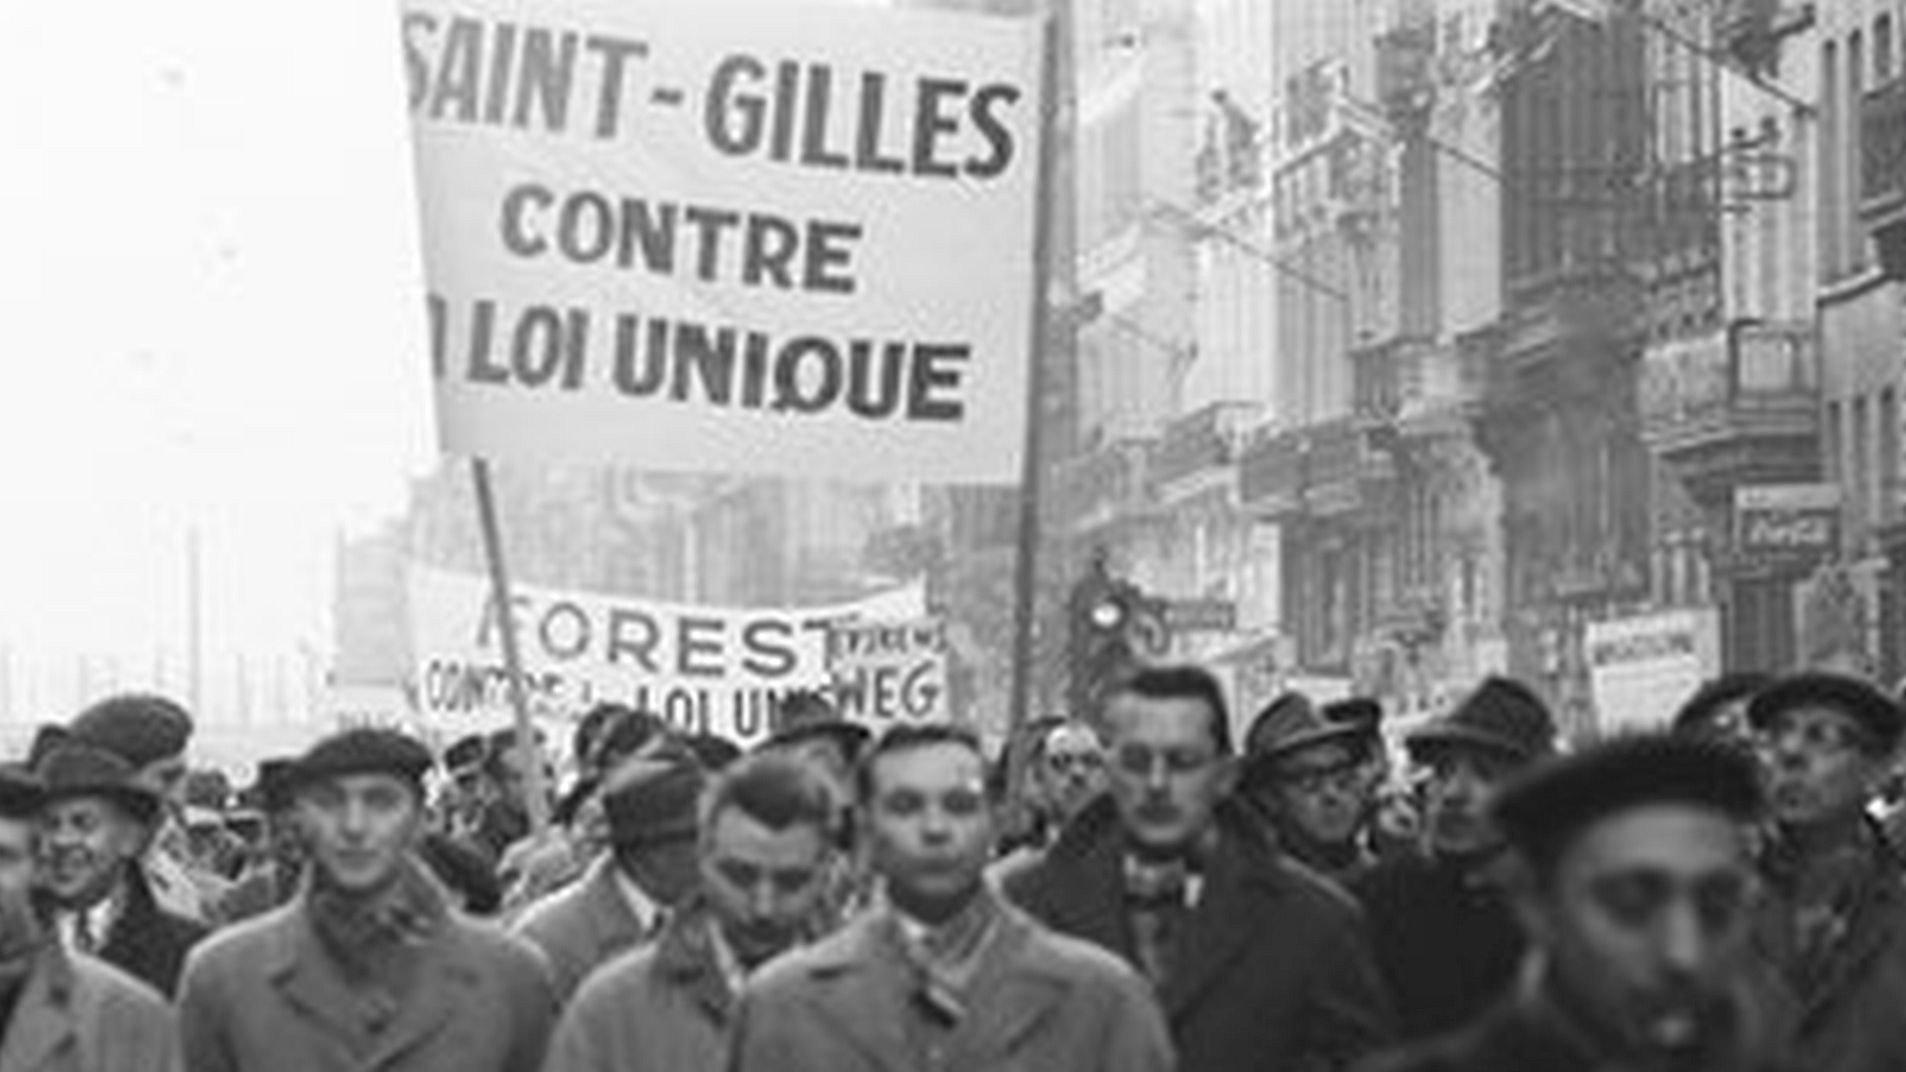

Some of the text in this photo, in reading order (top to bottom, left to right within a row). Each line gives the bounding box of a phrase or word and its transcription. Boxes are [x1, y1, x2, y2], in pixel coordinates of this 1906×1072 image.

[500, 183, 862, 294] CONTRE
[466, 299, 590, 391] LOI
[610, 311, 971, 422] UNIQUE
